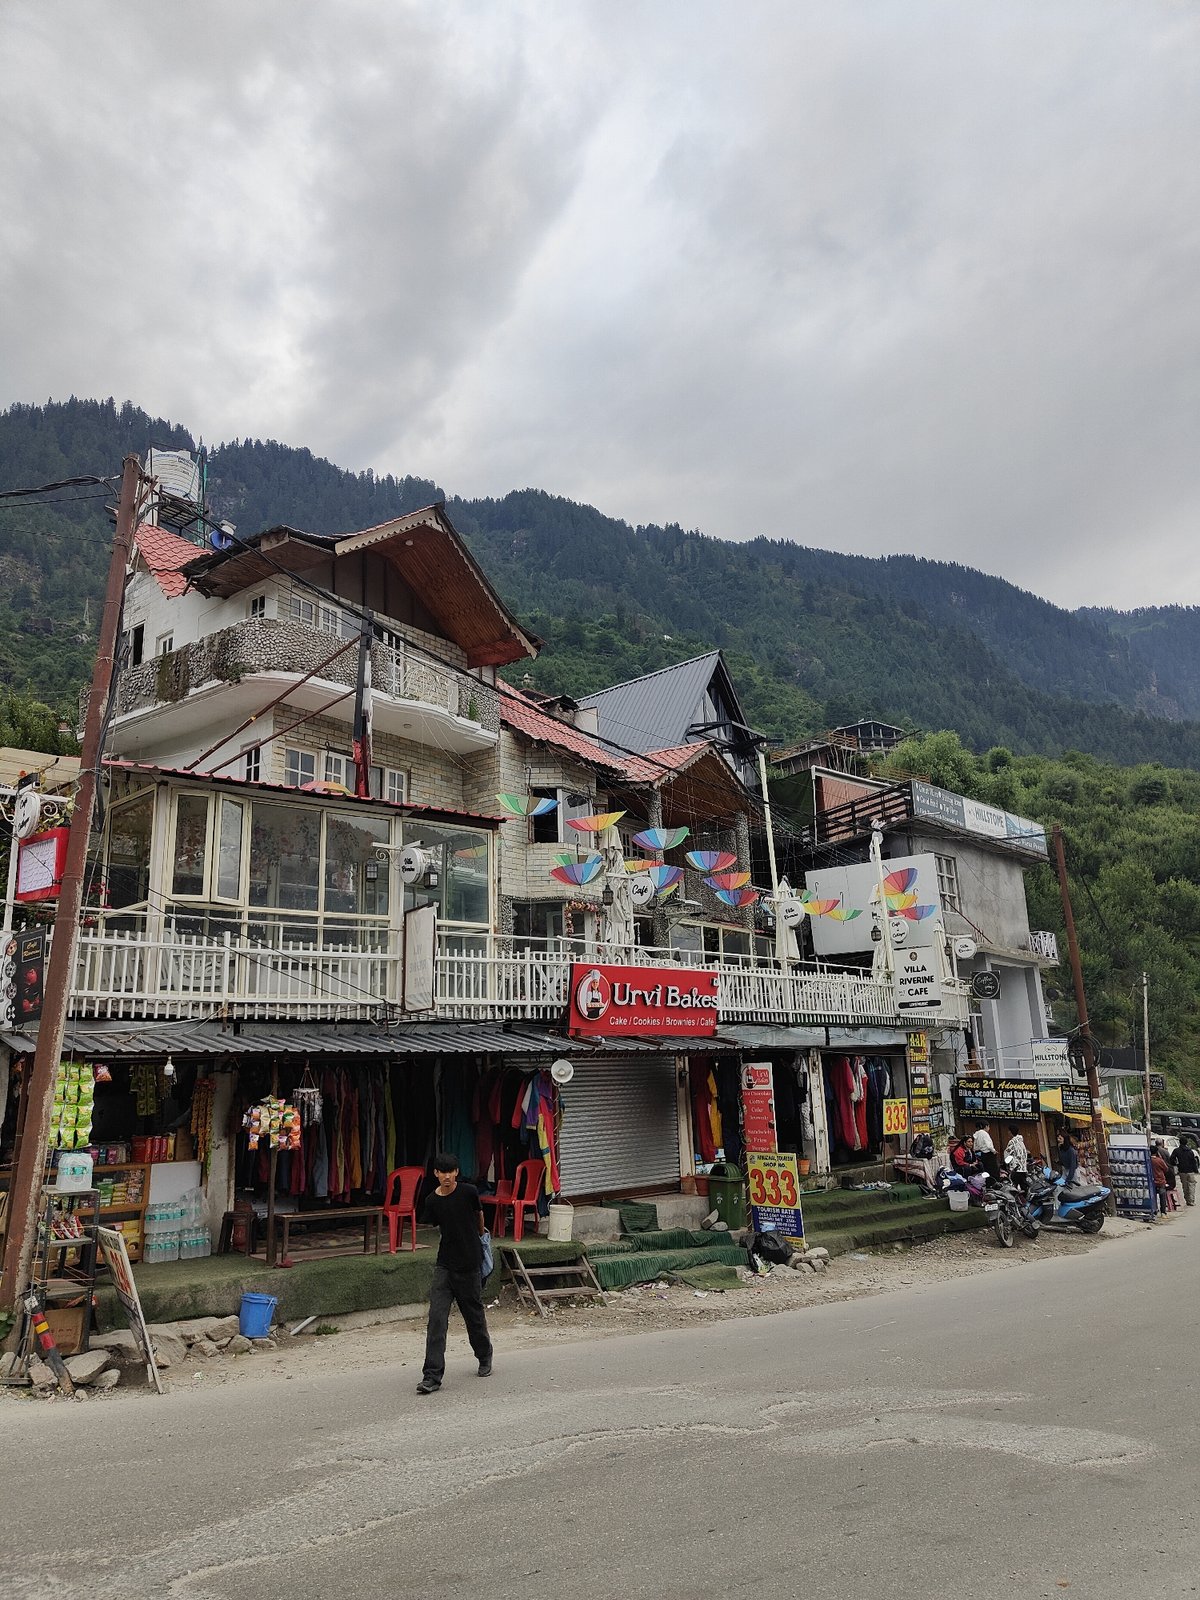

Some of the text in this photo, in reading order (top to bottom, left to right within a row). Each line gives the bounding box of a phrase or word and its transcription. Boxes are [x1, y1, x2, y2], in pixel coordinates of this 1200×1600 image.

[632, 884, 648, 897] Café
[904, 964, 927, 973] VILLA
[899, 975, 934, 986] RIVERINE
[613, 982, 718, 1008] Urvi Bakes
[609, 1016, 627, 1026] Cake
[633, 1016, 660, 1026] Cookies
[666, 1017, 695, 1026] Brownies
[700, 1017, 714, 1026] Café
[958, 1079, 980, 1089] Route
[982, 1079, 995, 1089] 21
[998, 1080, 1037, 1090] Adventure
[999, 1090, 1013, 1099] Taxi
[1023, 1091, 1037, 1099] Hire
[885, 1105, 907, 1132] 333
[750, 1168, 797, 1207] 333
